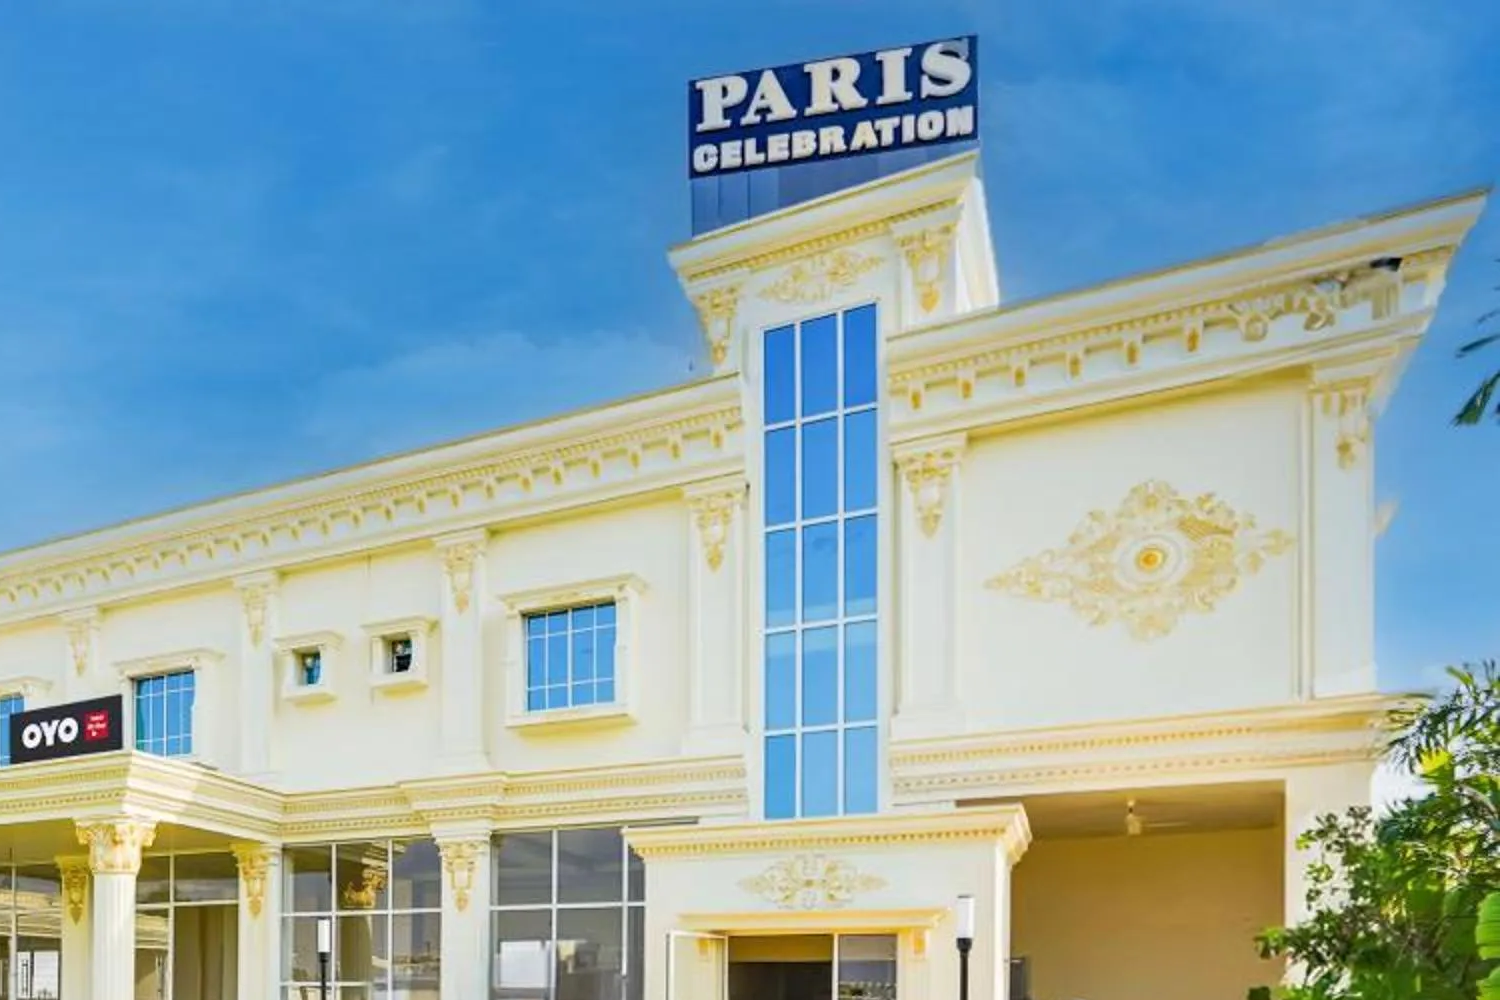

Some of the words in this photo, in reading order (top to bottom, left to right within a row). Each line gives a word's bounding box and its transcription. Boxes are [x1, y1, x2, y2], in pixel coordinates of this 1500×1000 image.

[694, 37, 972, 133] PARIS
[693, 104, 974, 173] CELEBRATION
[22, 717, 78, 749] OYO
